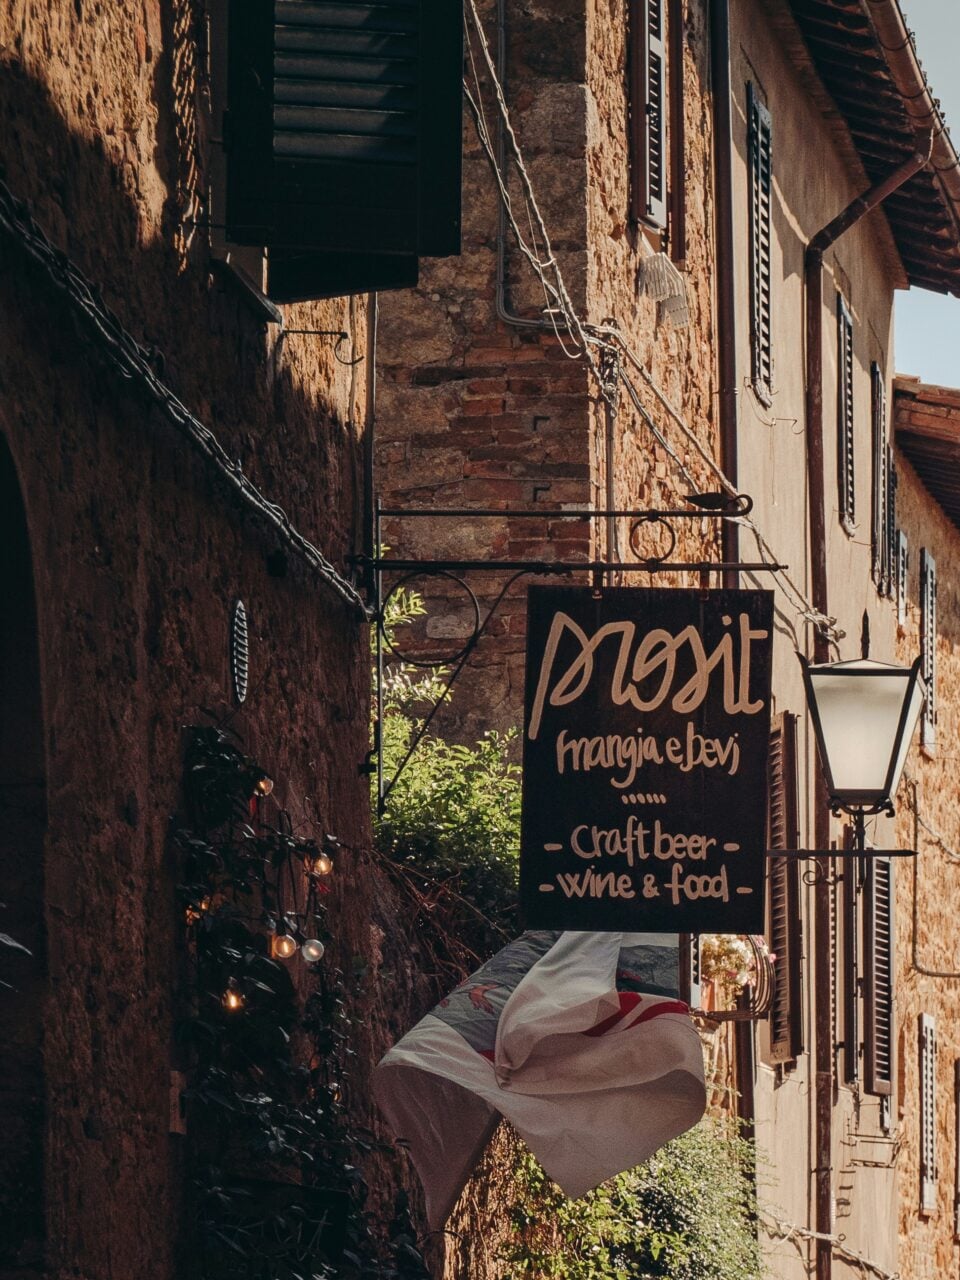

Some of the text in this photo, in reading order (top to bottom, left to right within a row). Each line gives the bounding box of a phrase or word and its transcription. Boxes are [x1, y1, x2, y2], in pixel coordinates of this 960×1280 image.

[528, 611, 769, 740] prosit
[654, 819, 717, 860] beer
[556, 862, 730, 905] wine & food
